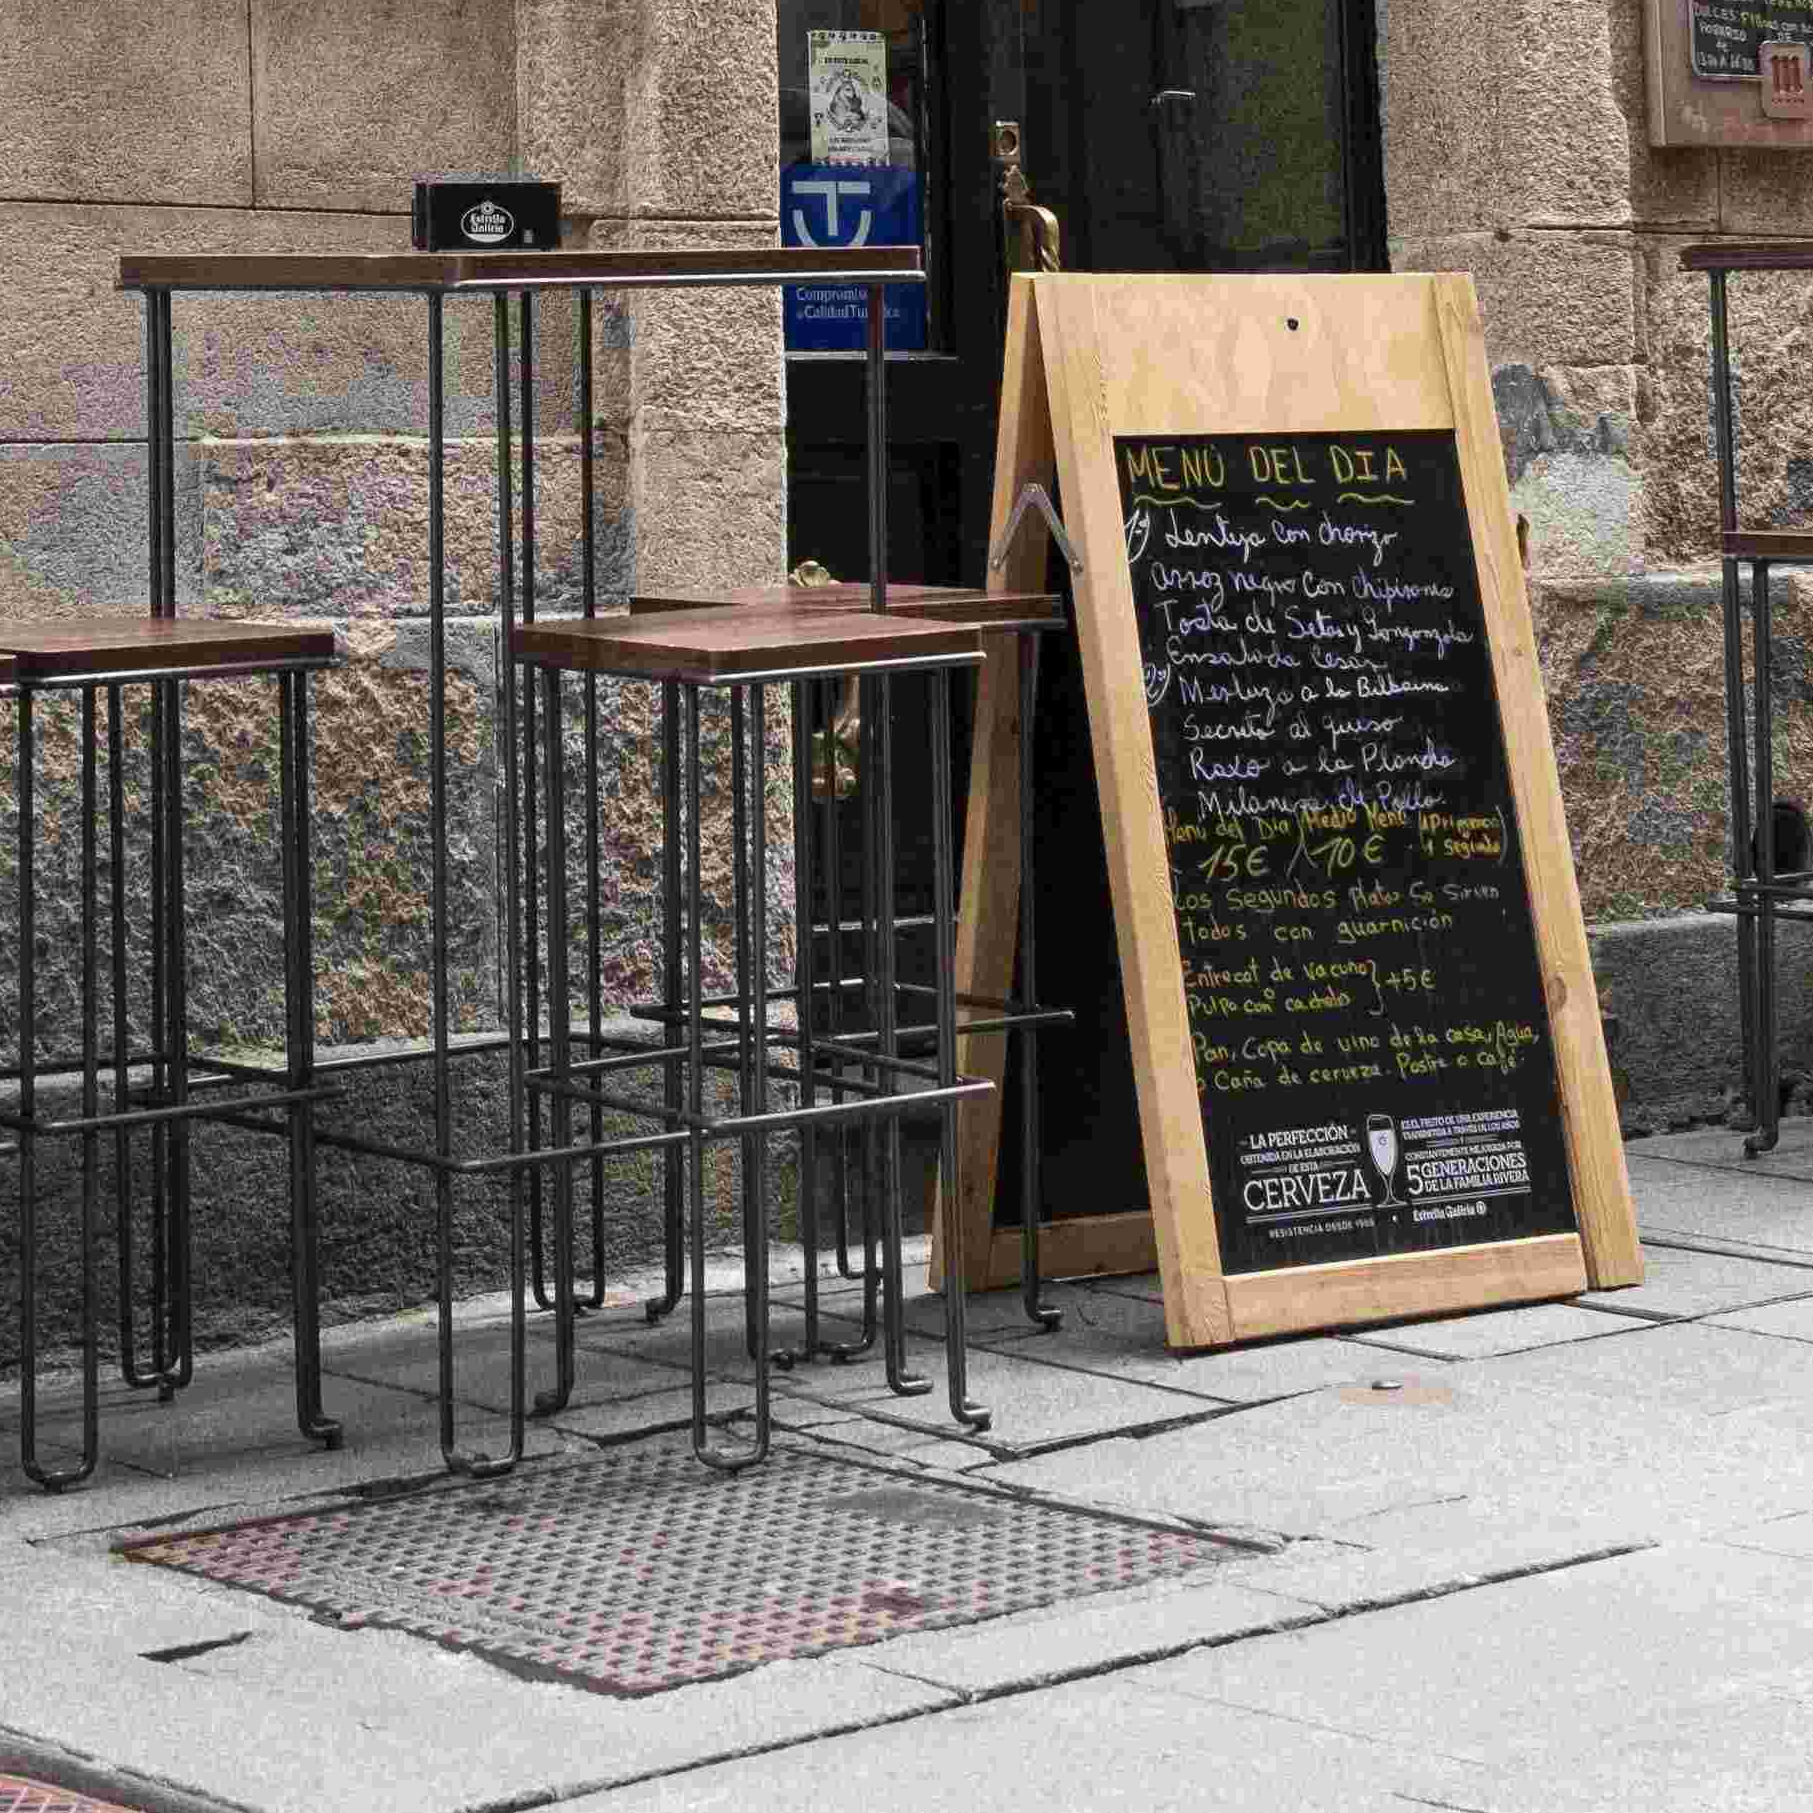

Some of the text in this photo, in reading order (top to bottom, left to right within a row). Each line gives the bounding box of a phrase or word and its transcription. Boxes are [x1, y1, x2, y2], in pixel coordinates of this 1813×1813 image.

[1249, 445, 1315, 485] DEL
[1329, 444, 1408, 485] DIA
[1245, 597, 1277, 635] de
[1300, 683, 1319, 702] a
[1288, 709, 1314, 740] al
[1197, 832, 1386, 885] 15€ 10€
[1273, 924, 1316, 941] con
[1270, 956, 1294, 984] de
[1299, 1030, 1324, 1056] de
[1389, 1021, 1411, 1048] de
[1213, 1069, 1268, 1092] Caña
[1278, 1063, 1304, 1086] de
[1250, 1121, 1349, 1150] LA PERFECCIÓN
[1406, 1151, 1527, 1196] 5 GENERACIONES
[1424, 1179, 1439, 1193] DE
[1492, 1168, 1531, 1187] RIVERA
[1244, 1168, 1373, 1211] CERVEZA
